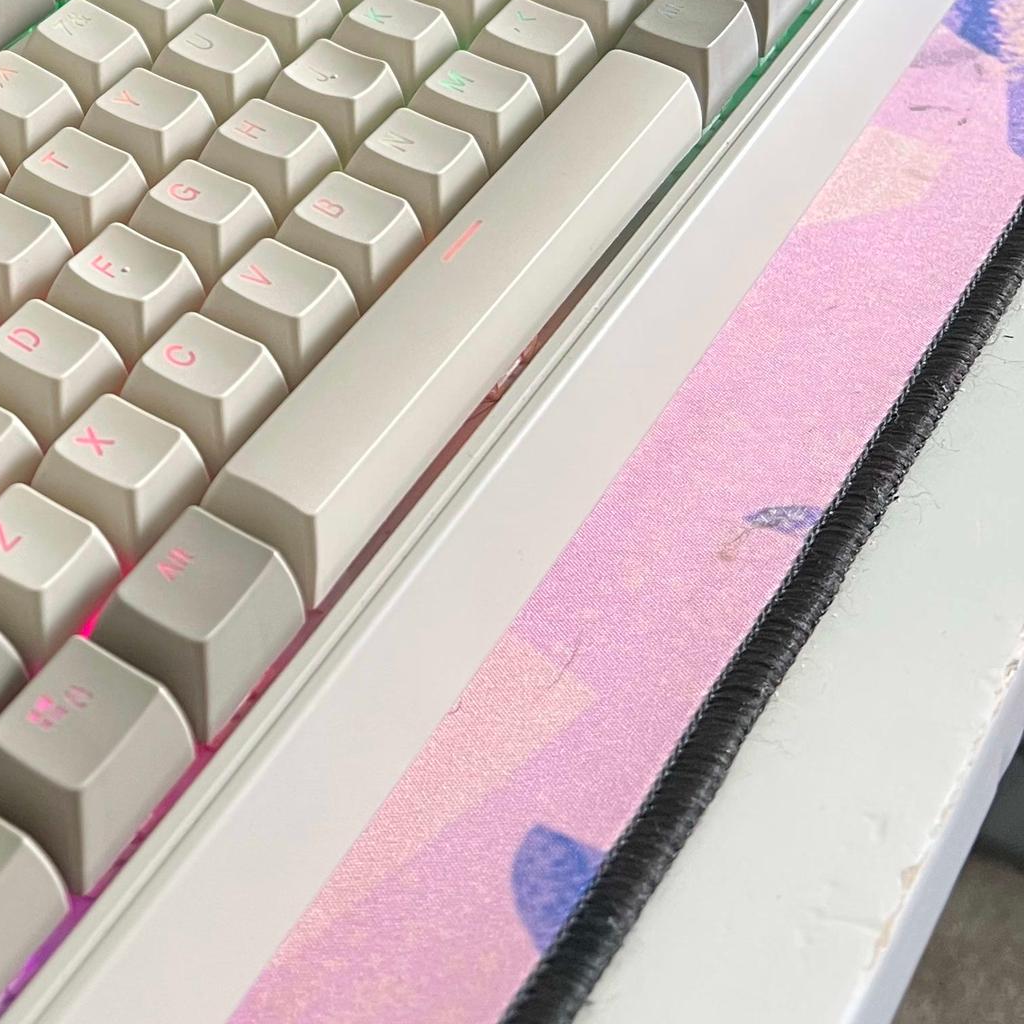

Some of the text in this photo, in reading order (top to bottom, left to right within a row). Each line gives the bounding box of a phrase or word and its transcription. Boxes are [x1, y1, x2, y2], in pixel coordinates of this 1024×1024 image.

[366, 5, 394, 25] K
[184, 31, 215, 51] U
[439, 68, 476, 94] M
[113, 88, 141, 108] Y
[234, 119, 267, 140] H
[381, 129, 416, 153] N
[40, 150, 70, 171] T
[167, 182, 202, 202] G
[312, 196, 346, 220] B
[89, 253, 116, 279] F
[239, 263, 273, 286] V
[5, 326, 42, 353] D
[162, 343, 197, 367] C
[73, 424, 117, 457] X
